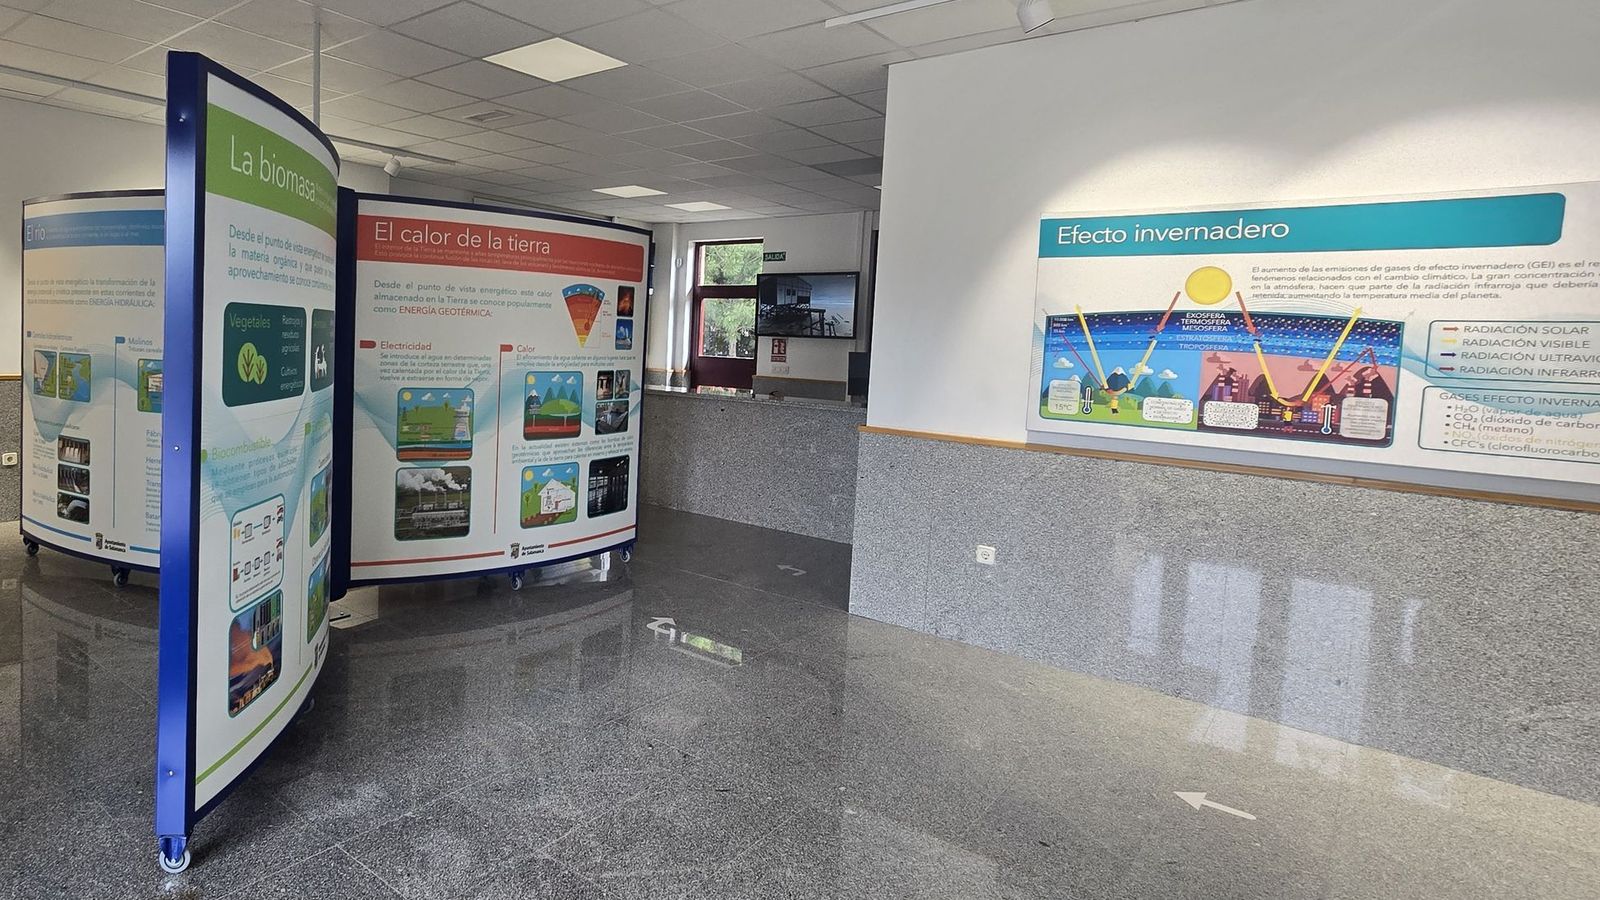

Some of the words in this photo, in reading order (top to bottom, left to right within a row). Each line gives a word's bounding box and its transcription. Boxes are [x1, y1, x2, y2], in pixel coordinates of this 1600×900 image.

[231, 135, 252, 176] La
[260, 145, 316, 202] biomasa
[1058, 225, 1127, 244] Efecto
[1134, 218, 1290, 242] invernadero
[229, 224, 255, 242] Desde
[257, 232, 264, 244] el
[265, 236, 284, 248] punto
[285, 240, 292, 251] de
[375, 221, 392, 241] El
[401, 224, 451, 245] calor
[457, 228, 481, 248] de
[488, 230, 502, 250] la
[508, 234, 549, 254] tierra
[228, 242, 236, 257] la
[242, 249, 269, 263] materia
[273, 255, 298, 269] orgánica
[1384, 265, 1411, 273] gases
[1462, 262, 1524, 270] invernadero
[1527, 261, 1555, 270] (GEI)
[228, 266, 288, 284] aprovechamiento
[1486, 273, 1510, 281] gran
[1514, 271, 1595, 279] concentración
[374, 280, 401, 289] Desde
[418, 283, 441, 292] punto
[445, 284, 455, 292] de
[460, 285, 476, 293] vista
[480, 287, 517, 296] energético
[521, 289, 534, 297] este
[1348, 284, 1365, 292] que
[1474, 282, 1521, 290] infrarroja
[374, 293, 424, 302] almacenado
[447, 296, 468, 304] Tierra
[507, 300, 552, 309] popularmente
[1461, 292, 1501, 300] planeta.
[399, 305, 437, 315] ENERGÍA
[438, 306, 493, 317] GEOTÉRMICA:
[229, 313, 271, 332] Vegetales
[1464, 325, 1538, 334] RADIACIÓN
[1541, 326, 1589, 334] SOLAR
[128, 337, 152, 346] Molinos
[381, 341, 432, 350] Electricidad
[1462, 338, 1536, 348] RADIACIÓN
[1540, 340, 1590, 348] VISIBLE
[1461, 351, 1535, 361] RADIACIÓN
[1460, 365, 1533, 376] RADIACIÓN
[1537, 369, 1600, 377] INFRARR
[1440, 392, 1479, 401] GASES
[1483, 394, 1534, 404] EFECTO
[1481, 415, 1531, 425] (dióxido
[1545, 412, 1583, 420] agua)
[1479, 424, 1534, 435] (metano)
